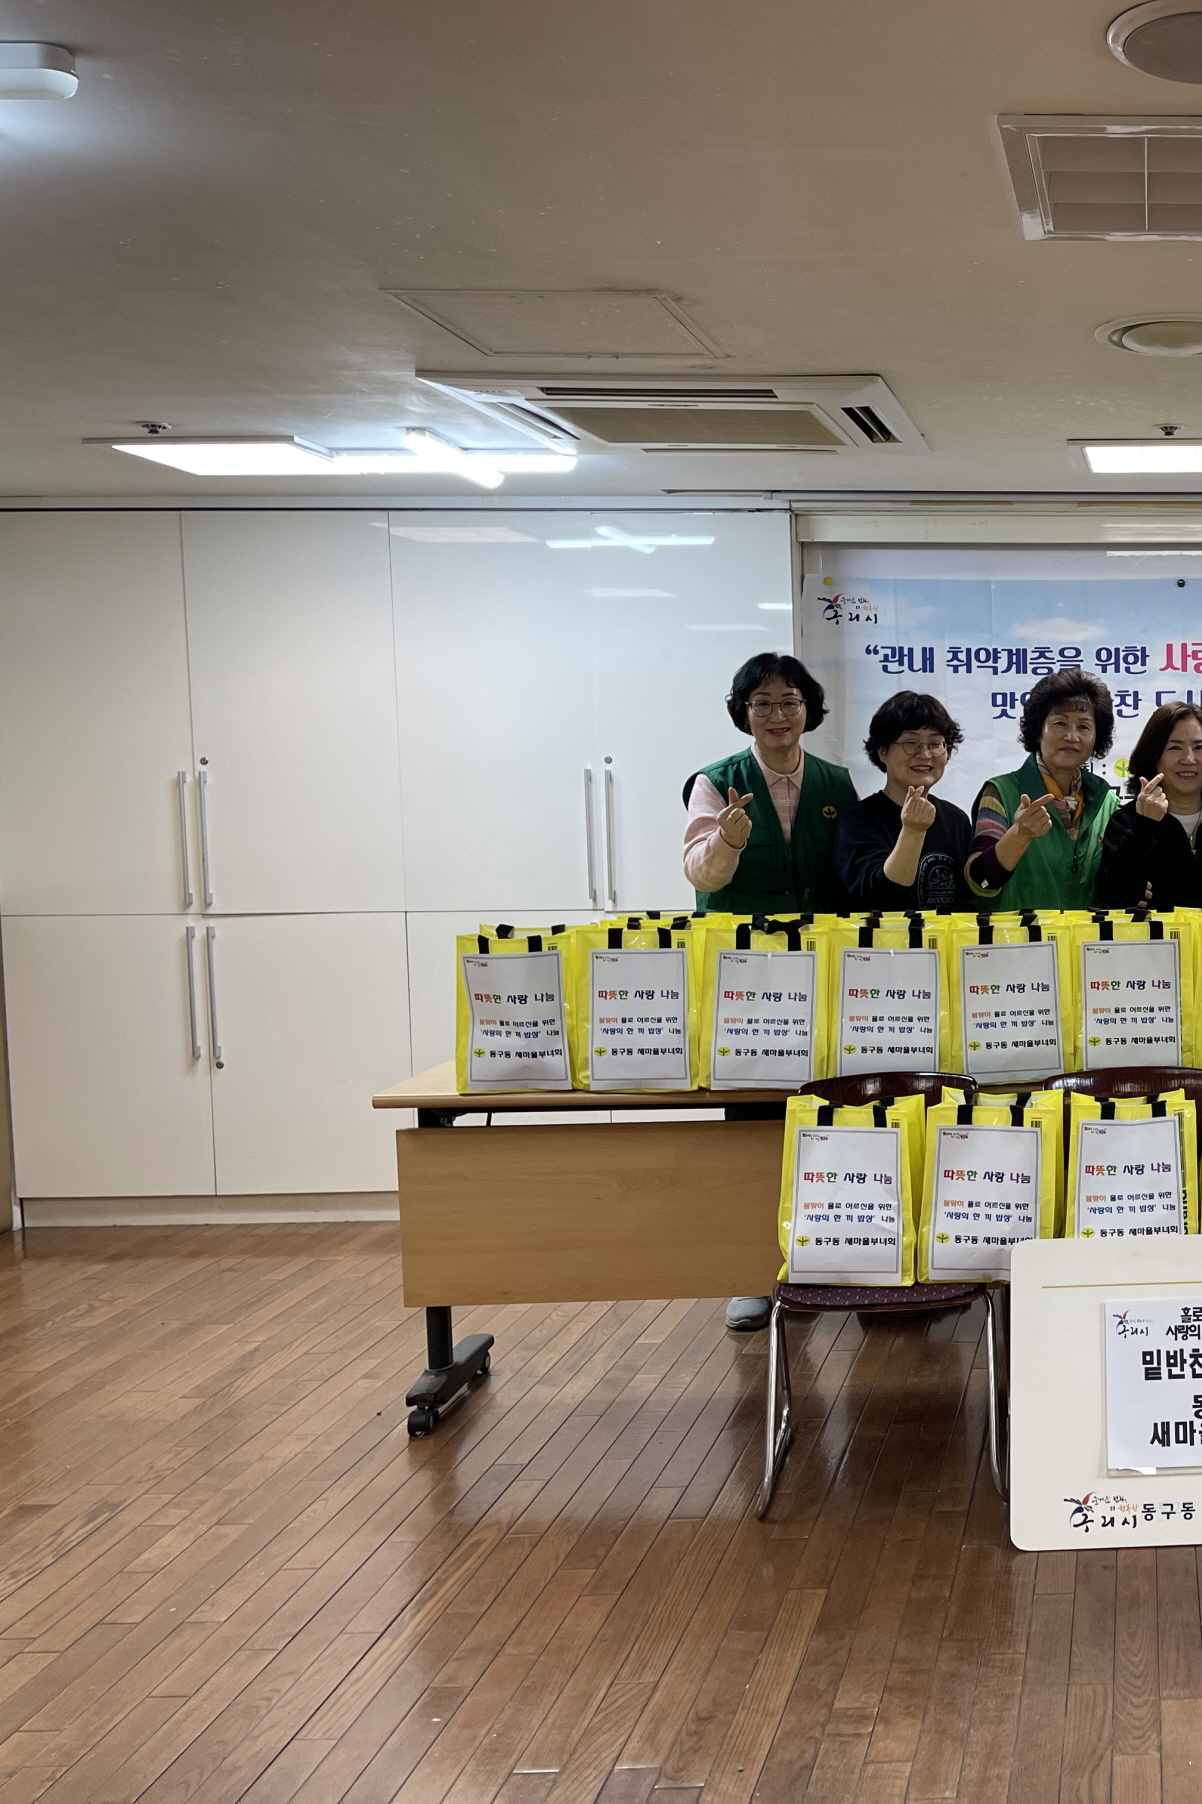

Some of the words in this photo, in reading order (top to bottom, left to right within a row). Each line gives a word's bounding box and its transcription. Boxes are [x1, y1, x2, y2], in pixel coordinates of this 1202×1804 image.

[865, 644, 935, 675] “관내
[946, 646, 1084, 676] 취약계층을
[1094, 645, 1150, 675] 위한
[970, 984, 1000, 995] 따뜻한
[1006, 984, 1026, 993] 사랑
[1031, 982, 1050, 992] 나눔
[1090, 980, 1121, 991] 따뜻한
[1126, 980, 1146, 990] 사랑
[1152, 980, 1171, 989] 나눔
[474, 993, 501, 1004] 따뜻한
[507, 994, 528, 1004] 사랑
[534, 992, 554, 1002] 나눔
[598, 990, 628, 1000] 따뜻한
[634, 990, 655, 1000] 사랑
[661, 990, 679, 999] 나눔
[724, 991, 756, 1001] 따뜻한
[762, 992, 782, 1002] 사랑
[788, 992, 807, 1001] 나눔
[849, 989, 880, 998] 따뜻한
[886, 990, 906, 999] 사랑
[912, 990, 931, 999] 나눔
[612, 1048, 633, 1056] 동구동
[637, 1047, 682, 1055] 새마을부녀회
[861, 1046, 883, 1054] 동구동
[887, 1046, 933, 1054] 새마을부녀회
[1085, 1165, 1117, 1176] 따뜻한
[1123, 1164, 1145, 1175] 사랑
[1151, 1162, 1171, 1173] 나눔
[804, 1172, 838, 1183] 따뜻한
[844, 1173, 867, 1184] 사랑
[874, 1174, 892, 1184] 나눔
[944, 1170, 978, 1181] 따뜻한
[983, 1172, 1005, 1183] 사랑
[1010, 1173, 1031, 1184] 나눔
[1100, 1229, 1124, 1237] 동구동
[1129, 1225, 1178, 1236] 새마을부녀회
[815, 1238, 840, 1246] 동구동
[844, 1237, 896, 1246] 새마을부녀회
[955, 1235, 978, 1244] 동구동
[1165, 1323, 1202, 1341] 사랑의
[1141, 1502, 1195, 1521] 동구동
